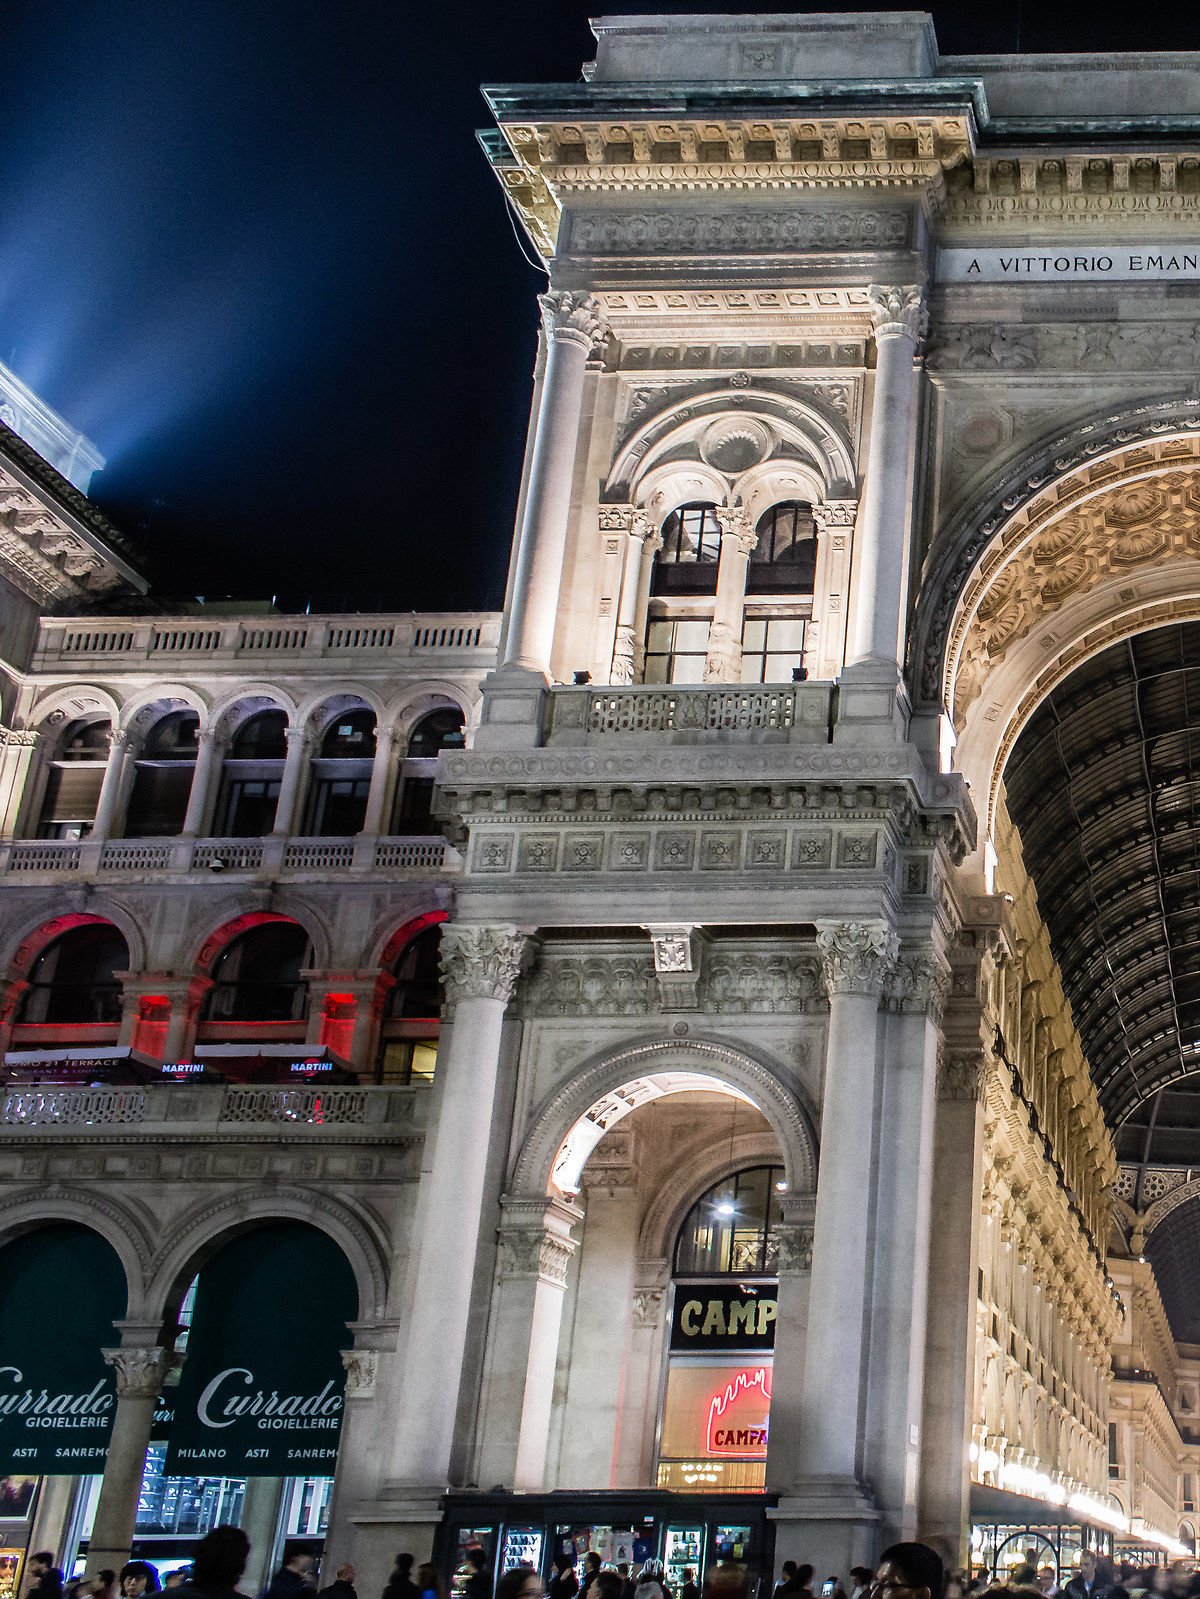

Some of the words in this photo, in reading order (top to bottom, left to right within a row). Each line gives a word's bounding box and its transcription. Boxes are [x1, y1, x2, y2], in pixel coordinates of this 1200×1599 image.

[967, 258, 982, 273] A
[1000, 256, 1113, 273] VITTORIO
[65, 1059, 119, 1067] TERRACE
[162, 1064, 204, 1073] MARTINI
[291, 1062, 333, 1071] MARTINI
[681, 1299, 778, 1336] CAMP
[197, 1367, 343, 1429] Currado
[26, 1416, 109, 1428] GIOIELLERIE
[258, 1418, 339, 1430] GIOIELLERIE
[12, 1448, 38, 1458] ASTI
[178, 1448, 227, 1458] MILANO
[245, 1448, 269, 1458] ASTI
[287, 1448, 339, 1458] SANREM
